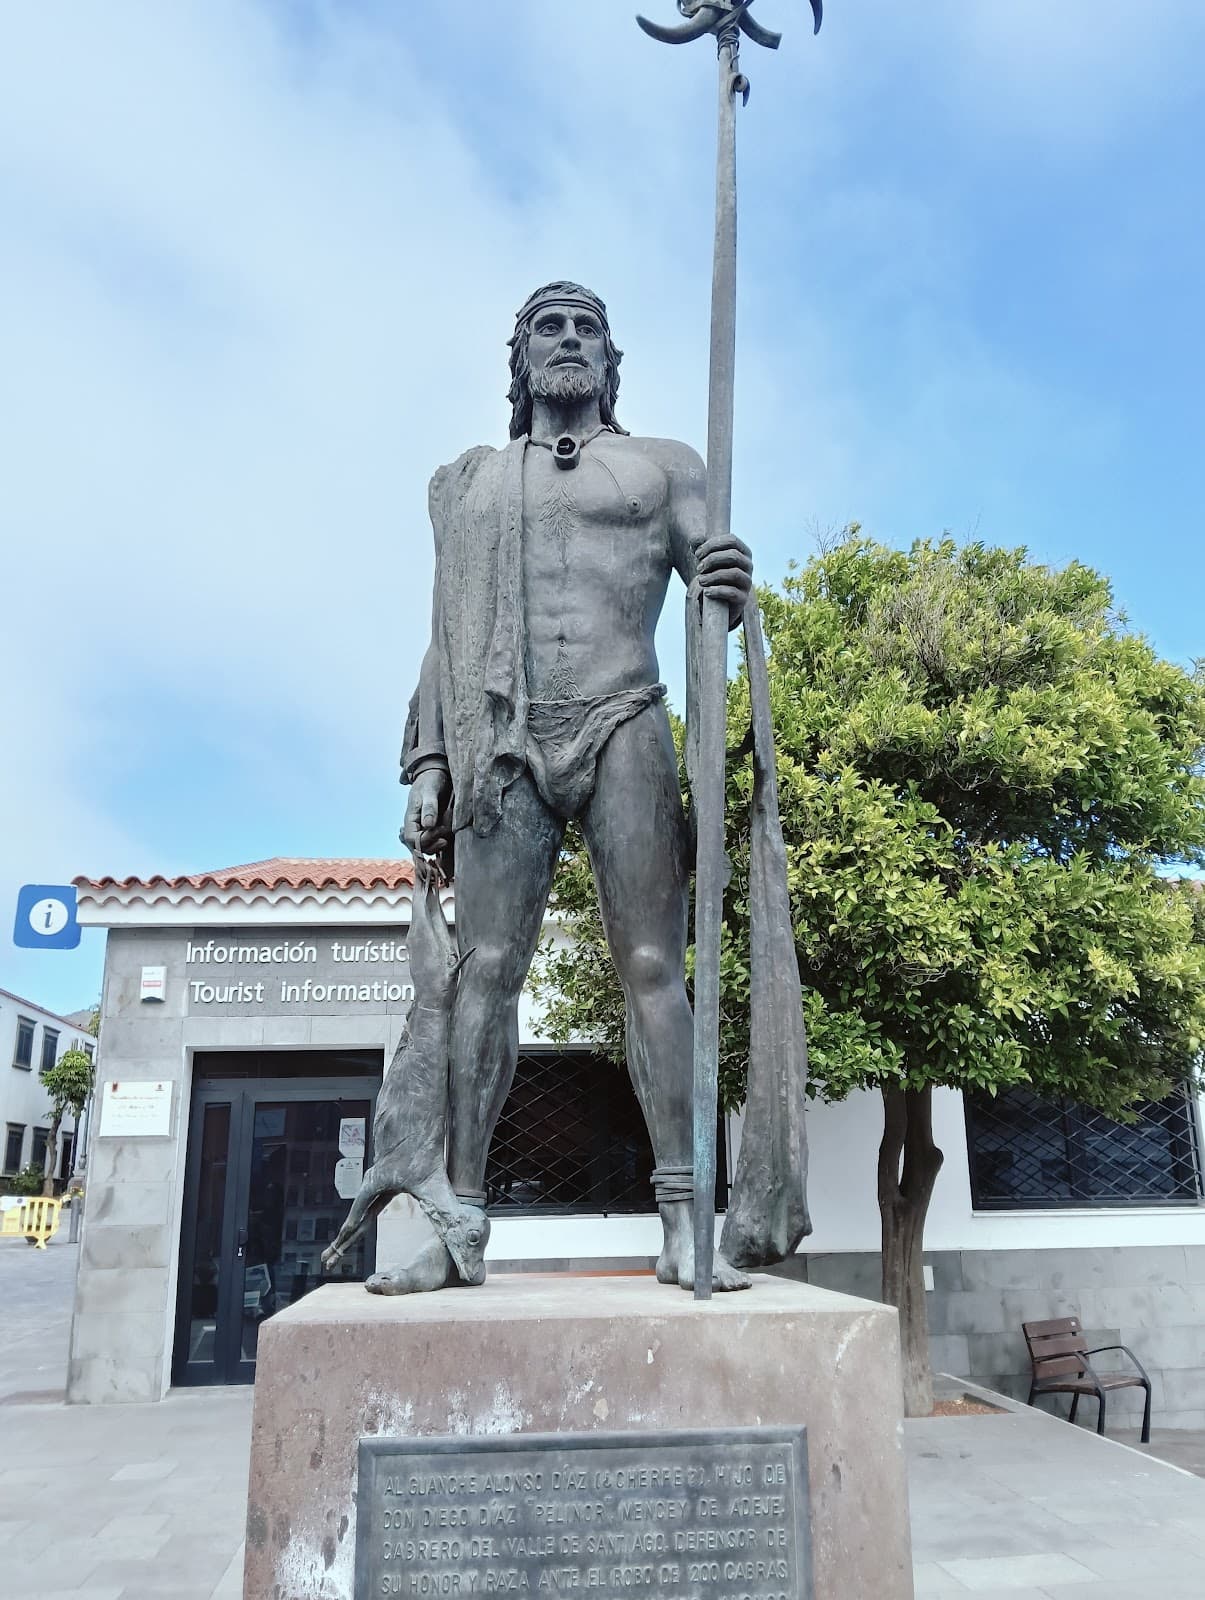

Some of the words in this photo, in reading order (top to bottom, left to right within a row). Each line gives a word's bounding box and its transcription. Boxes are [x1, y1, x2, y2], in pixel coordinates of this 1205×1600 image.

[186, 940, 317, 964] Información
[331, 940, 410, 963] turístic
[190, 980, 265, 1003] Tourist
[281, 979, 415, 1003] information
[384, 1476, 403, 1496] AL
[408, 1475, 477, 1496] GUANCHE
[483, 1472, 543, 1495] ALONSO
[551, 1463, 587, 1490] DÍAZ
[763, 1463, 786, 1485] DE
[383, 1508, 415, 1529] DON
[423, 1507, 469, 1527] DIEGO
[622, 1499, 687, 1521] MENCEY
[699, 1498, 718, 1518] DE
[471, 1538, 500, 1558] DEL
[506, 1536, 555, 1558] VALLE
[559, 1535, 580, 1555] DE
[674, 1529, 756, 1552] DEFENSOR
[766, 1528, 787, 1548] DE
[382, 1575, 400, 1594] SU
[409, 1573, 461, 1595] HONOR
[468, 1571, 478, 1593] Y
[485, 1568, 529, 1593] RAZA
[538, 1567, 581, 1591] ANTE
[587, 1567, 607, 1588] EL
[610, 1565, 653, 1588] ROBO
[660, 1564, 681, 1585] DE
[689, 1562, 719, 1583] 200
[724, 1560, 788, 1582] CABRAS
